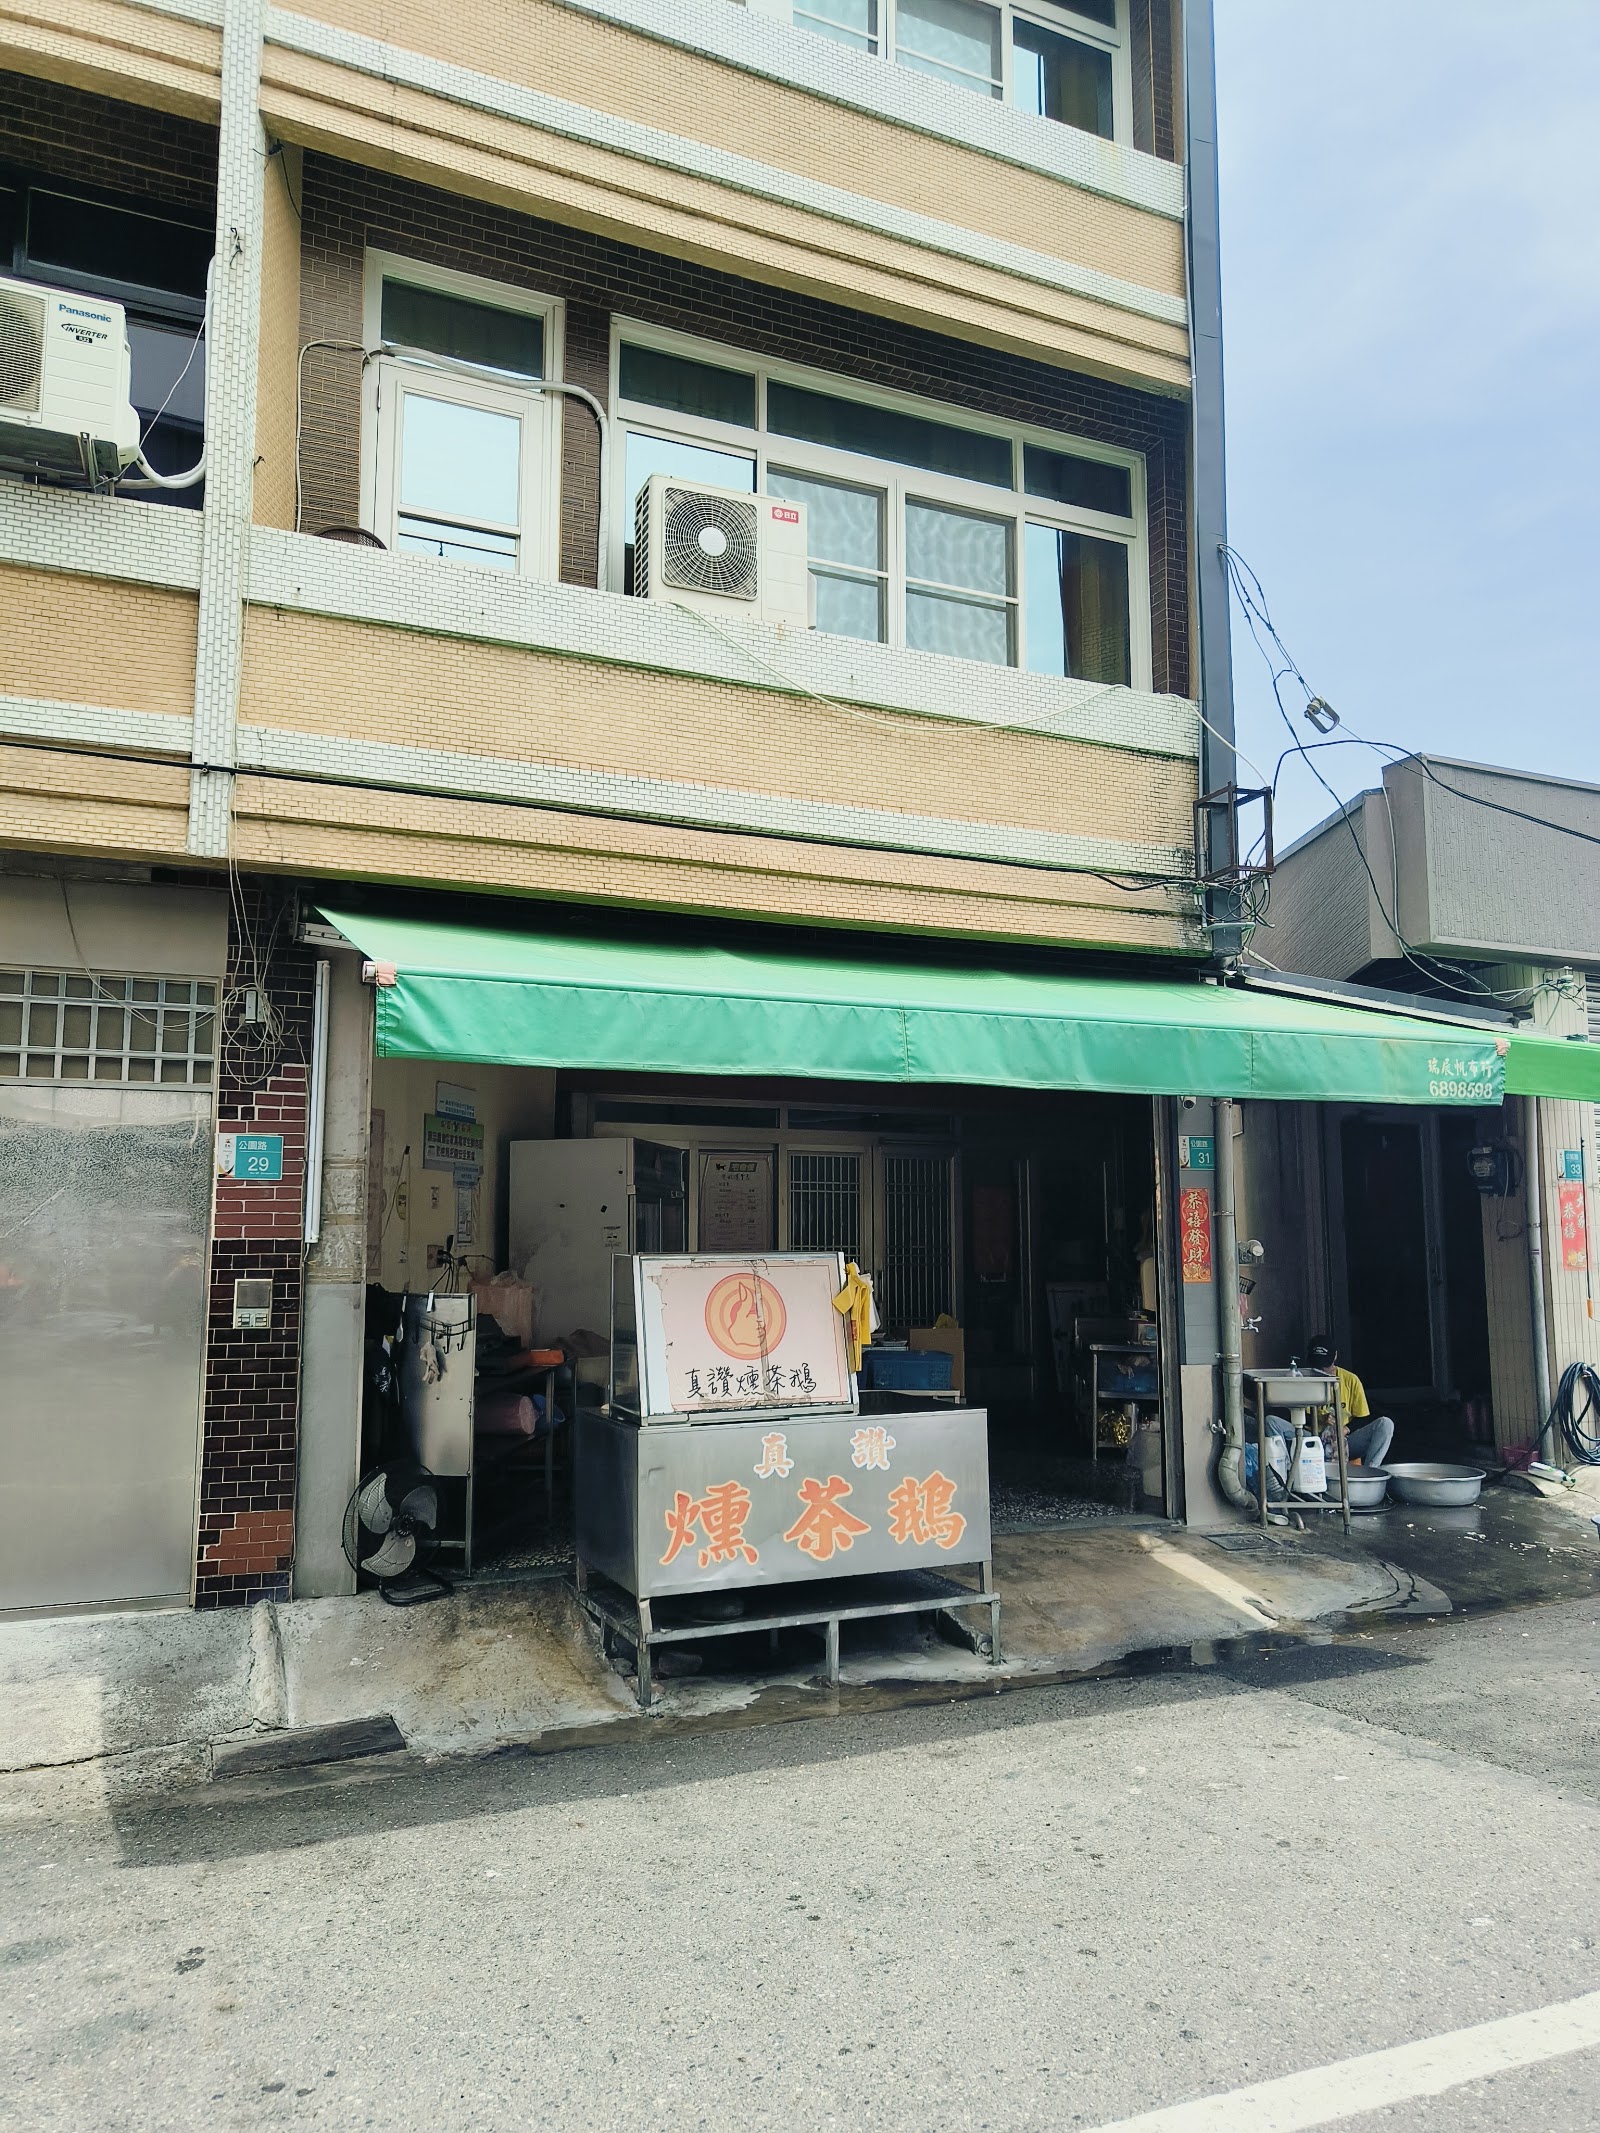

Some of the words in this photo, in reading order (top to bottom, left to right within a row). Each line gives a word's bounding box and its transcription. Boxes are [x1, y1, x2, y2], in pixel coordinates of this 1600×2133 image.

[59, 304, 111, 322] Panasonic
[66, 326, 108, 339] INVERTER
[785, 512, 796, 520] 日立
[1429, 1080, 1493, 1099] 6898598
[239, 1140, 267, 1150] 公園路
[248, 1156, 268, 1171] 29
[1198, 1152, 1210, 1164] 31
[1570, 1163, 1581, 1174] 33
[1186, 1193, 1205, 1262] 恭禧發財
[659, 1469, 967, 1568] 燻茶鵝
